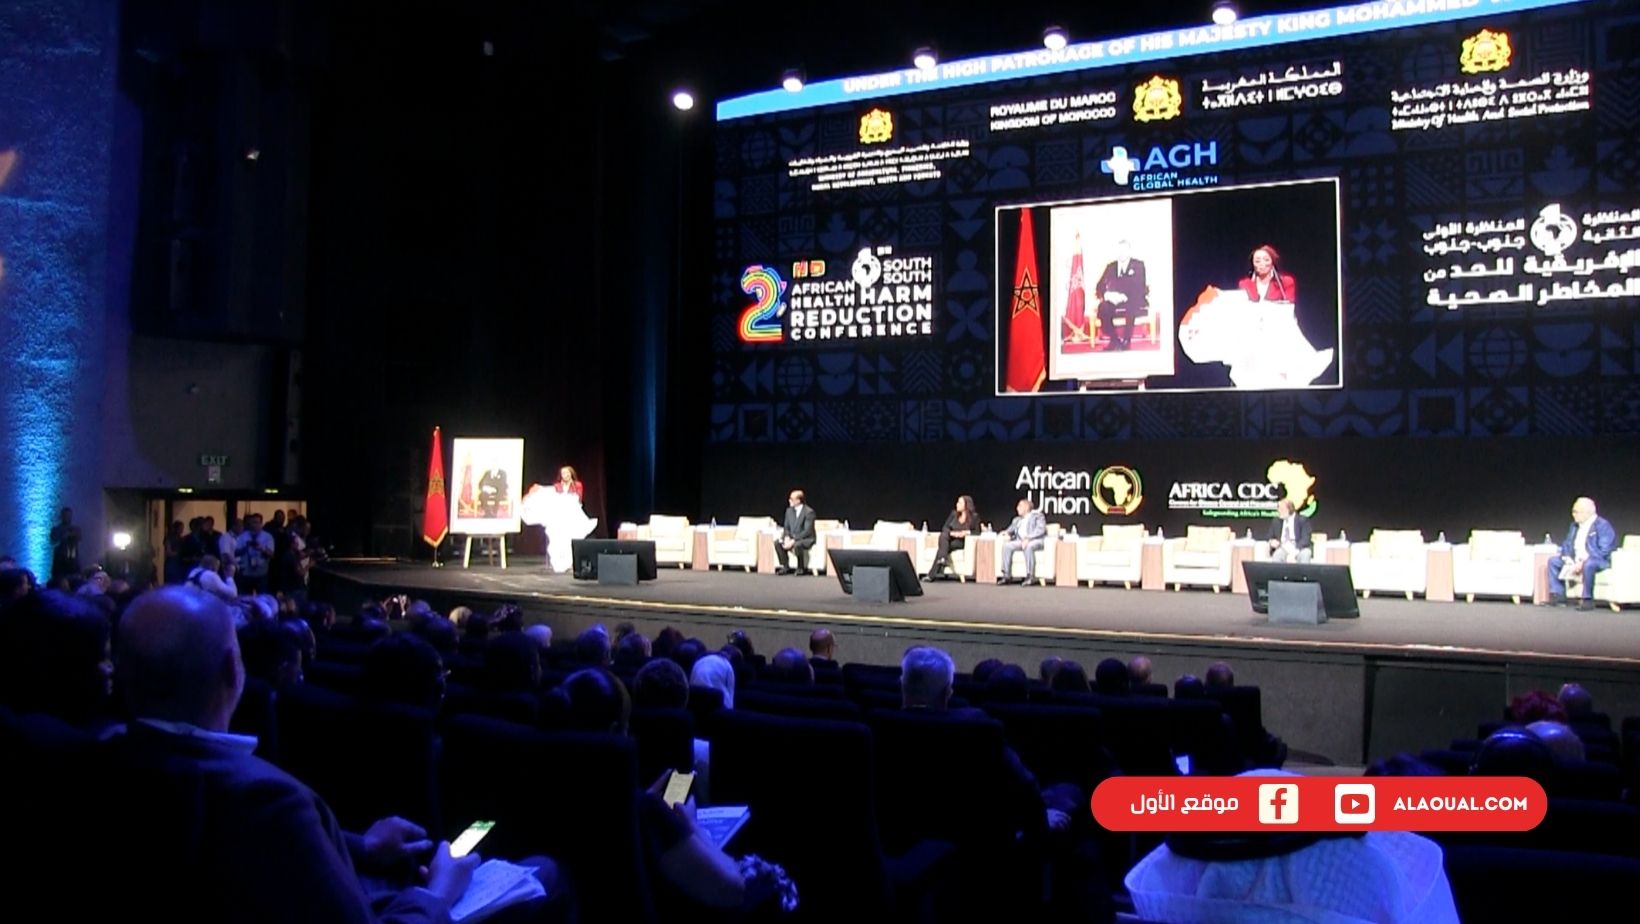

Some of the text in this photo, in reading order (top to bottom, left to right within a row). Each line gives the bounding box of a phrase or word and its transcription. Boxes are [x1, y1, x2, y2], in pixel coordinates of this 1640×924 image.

[844, 73, 900, 93] UNDER
[905, 67, 938, 84] THE
[943, 60, 986, 79] HIGH
[991, 44, 1104, 72] PATRONAGE
[1108, 39, 1135, 56] OF
[1140, 33, 1172, 50] HIS
[1178, 20, 1272, 47] MAJESTY
[1277, 12, 1330, 33] KING
[990, 91, 1116, 118] ROYAUME DU MAROC
[1447, 109, 1480, 124] Health
[1507, 102, 1537, 118] Social
[1537, 100, 1590, 115] Protection
[990, 107, 1116, 131] KINGDOM OF MOROCCO
[1144, 141, 1216, 171] AGH
[1133, 172, 1178, 182] AFRICAN
[1133, 175, 1218, 191] GLOBAL HEALTH
[883, 257, 932, 271] SOUTH
[791, 279, 855, 296] AFRICAN
[883, 270, 932, 285] SOUTH
[791, 284, 932, 310] HEALTH HARM
[1427, 283, 1534, 310] الصحية
[791, 303, 932, 328] REDUCTION
[791, 321, 932, 341] CONFERENCE
[201, 455, 228, 466] EXIT
[1015, 466, 1090, 490] African
[1168, 482, 1279, 499] AFRICA CDC
